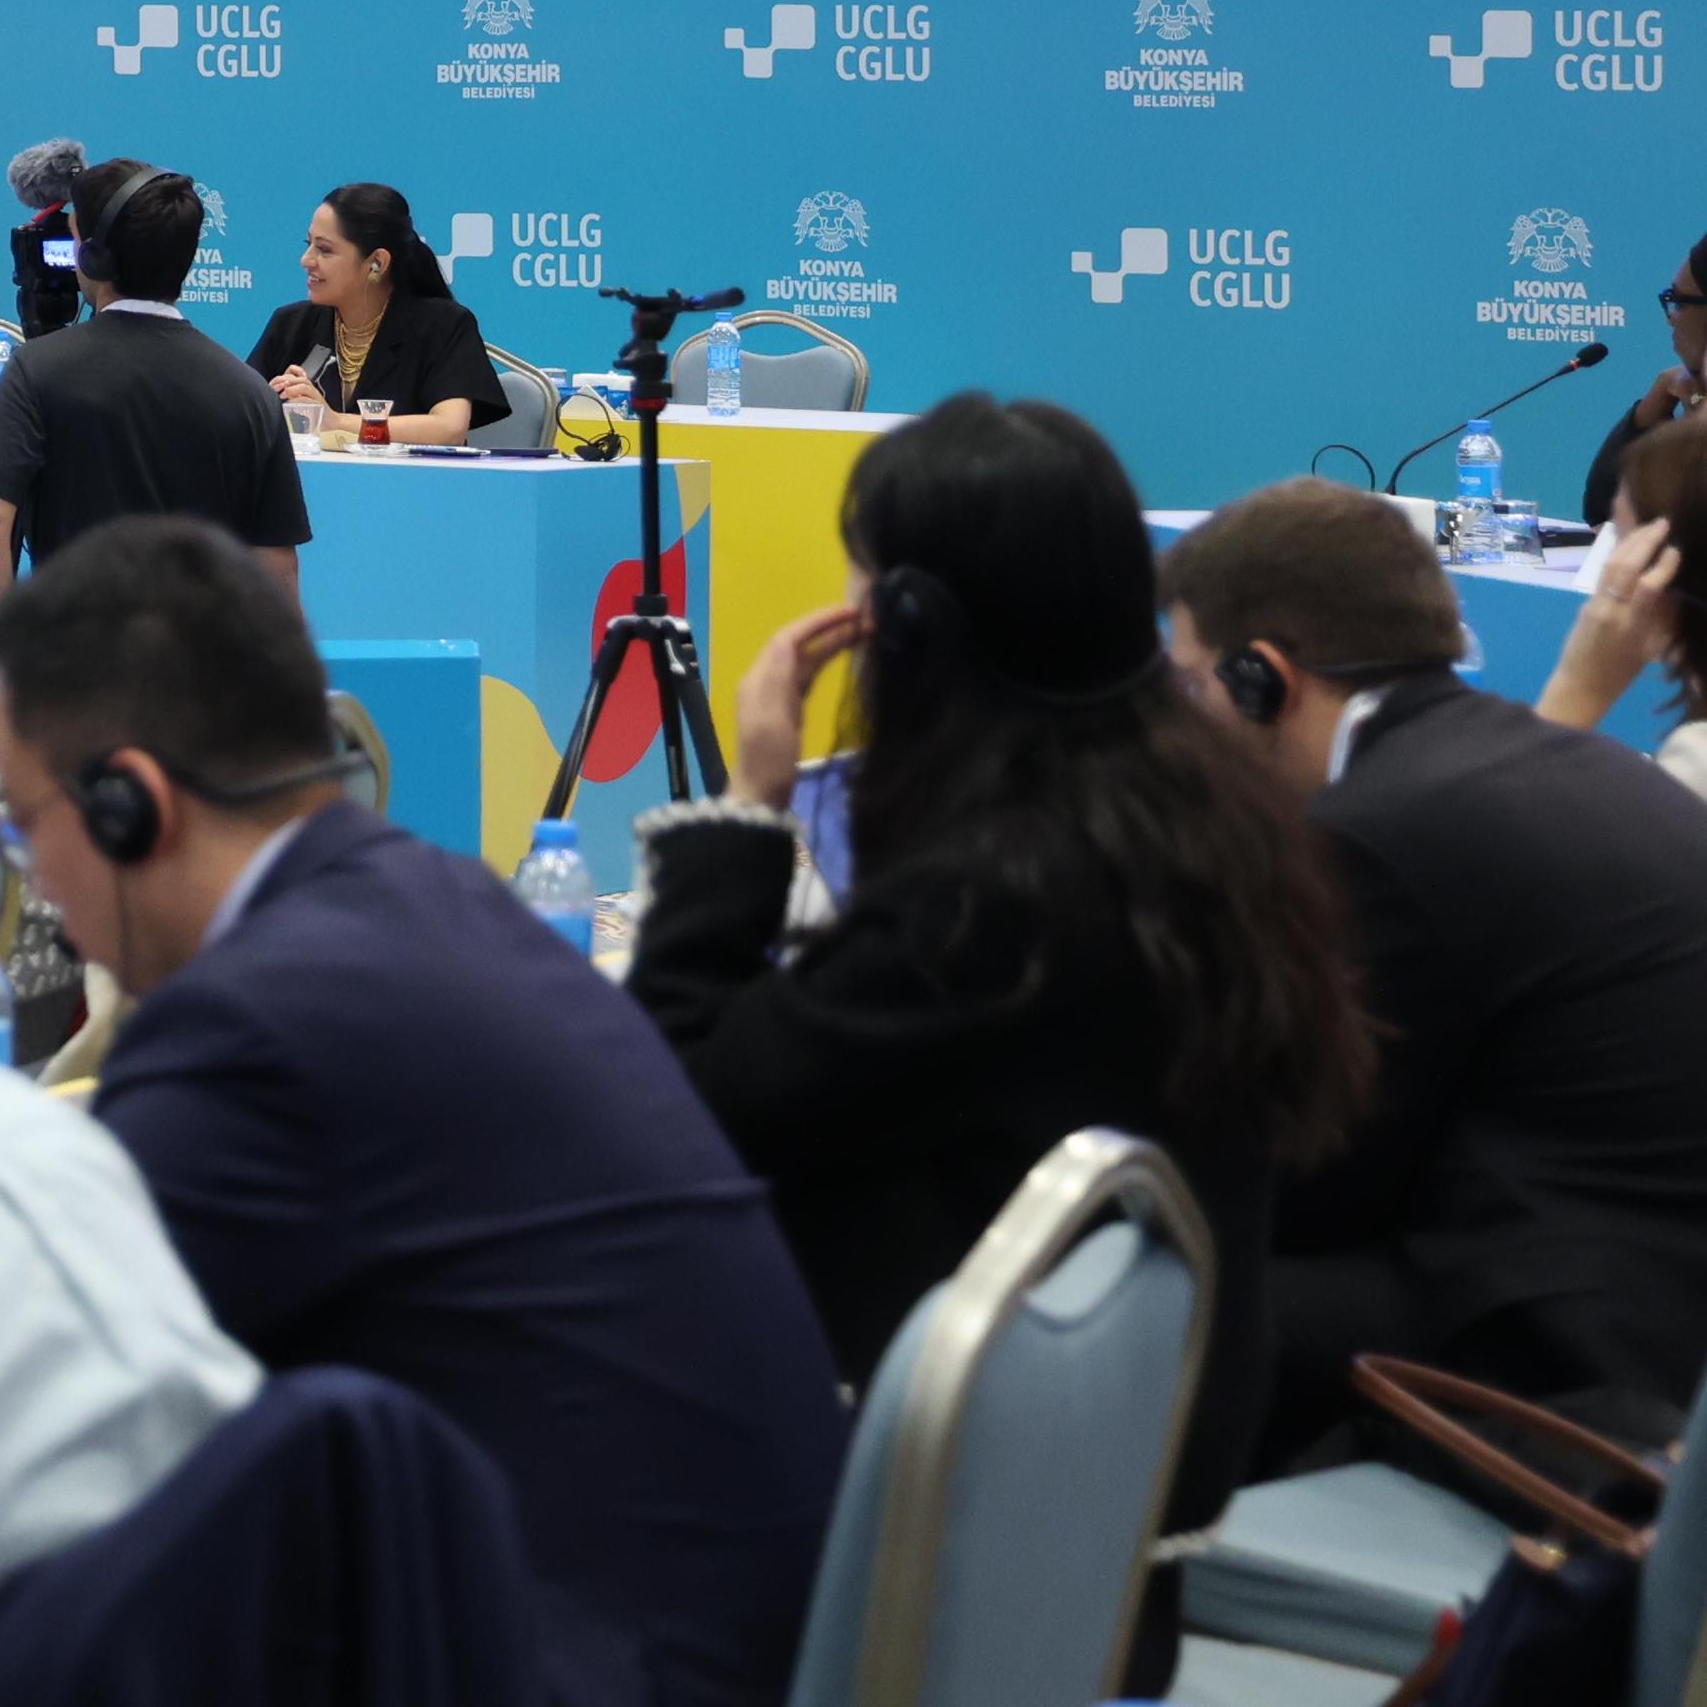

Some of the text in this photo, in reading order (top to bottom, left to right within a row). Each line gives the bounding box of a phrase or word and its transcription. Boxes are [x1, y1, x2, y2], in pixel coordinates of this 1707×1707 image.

[196, 5, 281, 38] UCLG
[836, 5, 930, 40] UCLG
[1555, 10, 1663, 47] UCLG
[197, 44, 281, 78] CGLU
[468, 43, 529, 59] KONYA
[836, 46, 930, 81] CGLU
[1140, 49, 1209, 66] KONYA
[437, 57, 560, 86] BÜYÜKŞEHİR
[1105, 66, 1243, 94] BÜYÜKŞEHİR
[1556, 54, 1663, 92] CGLU
[463, 84, 535, 98] BELEDİYESİ
[1134, 93, 1215, 108] BELEDİYESİ
[512, 213, 601, 247] UCLG
[1190, 229, 1290, 266] UCLG
[185, 266, 253, 290] KŞEHİR
[513, 253, 601, 288] CGLU
[800, 260, 864, 277] KONYA
[767, 276, 897, 304] BÜYÜKŞEHİR
[1190, 271, 1290, 309] CGLU
[1514, 280, 1587, 302] KONYA
[790, 303, 870, 321] BELEDİYESİ
[1477, 298, 1624, 328] BÜYÜKŞEHİR
[1507, 324, 1595, 342] BELEDİYESİ
